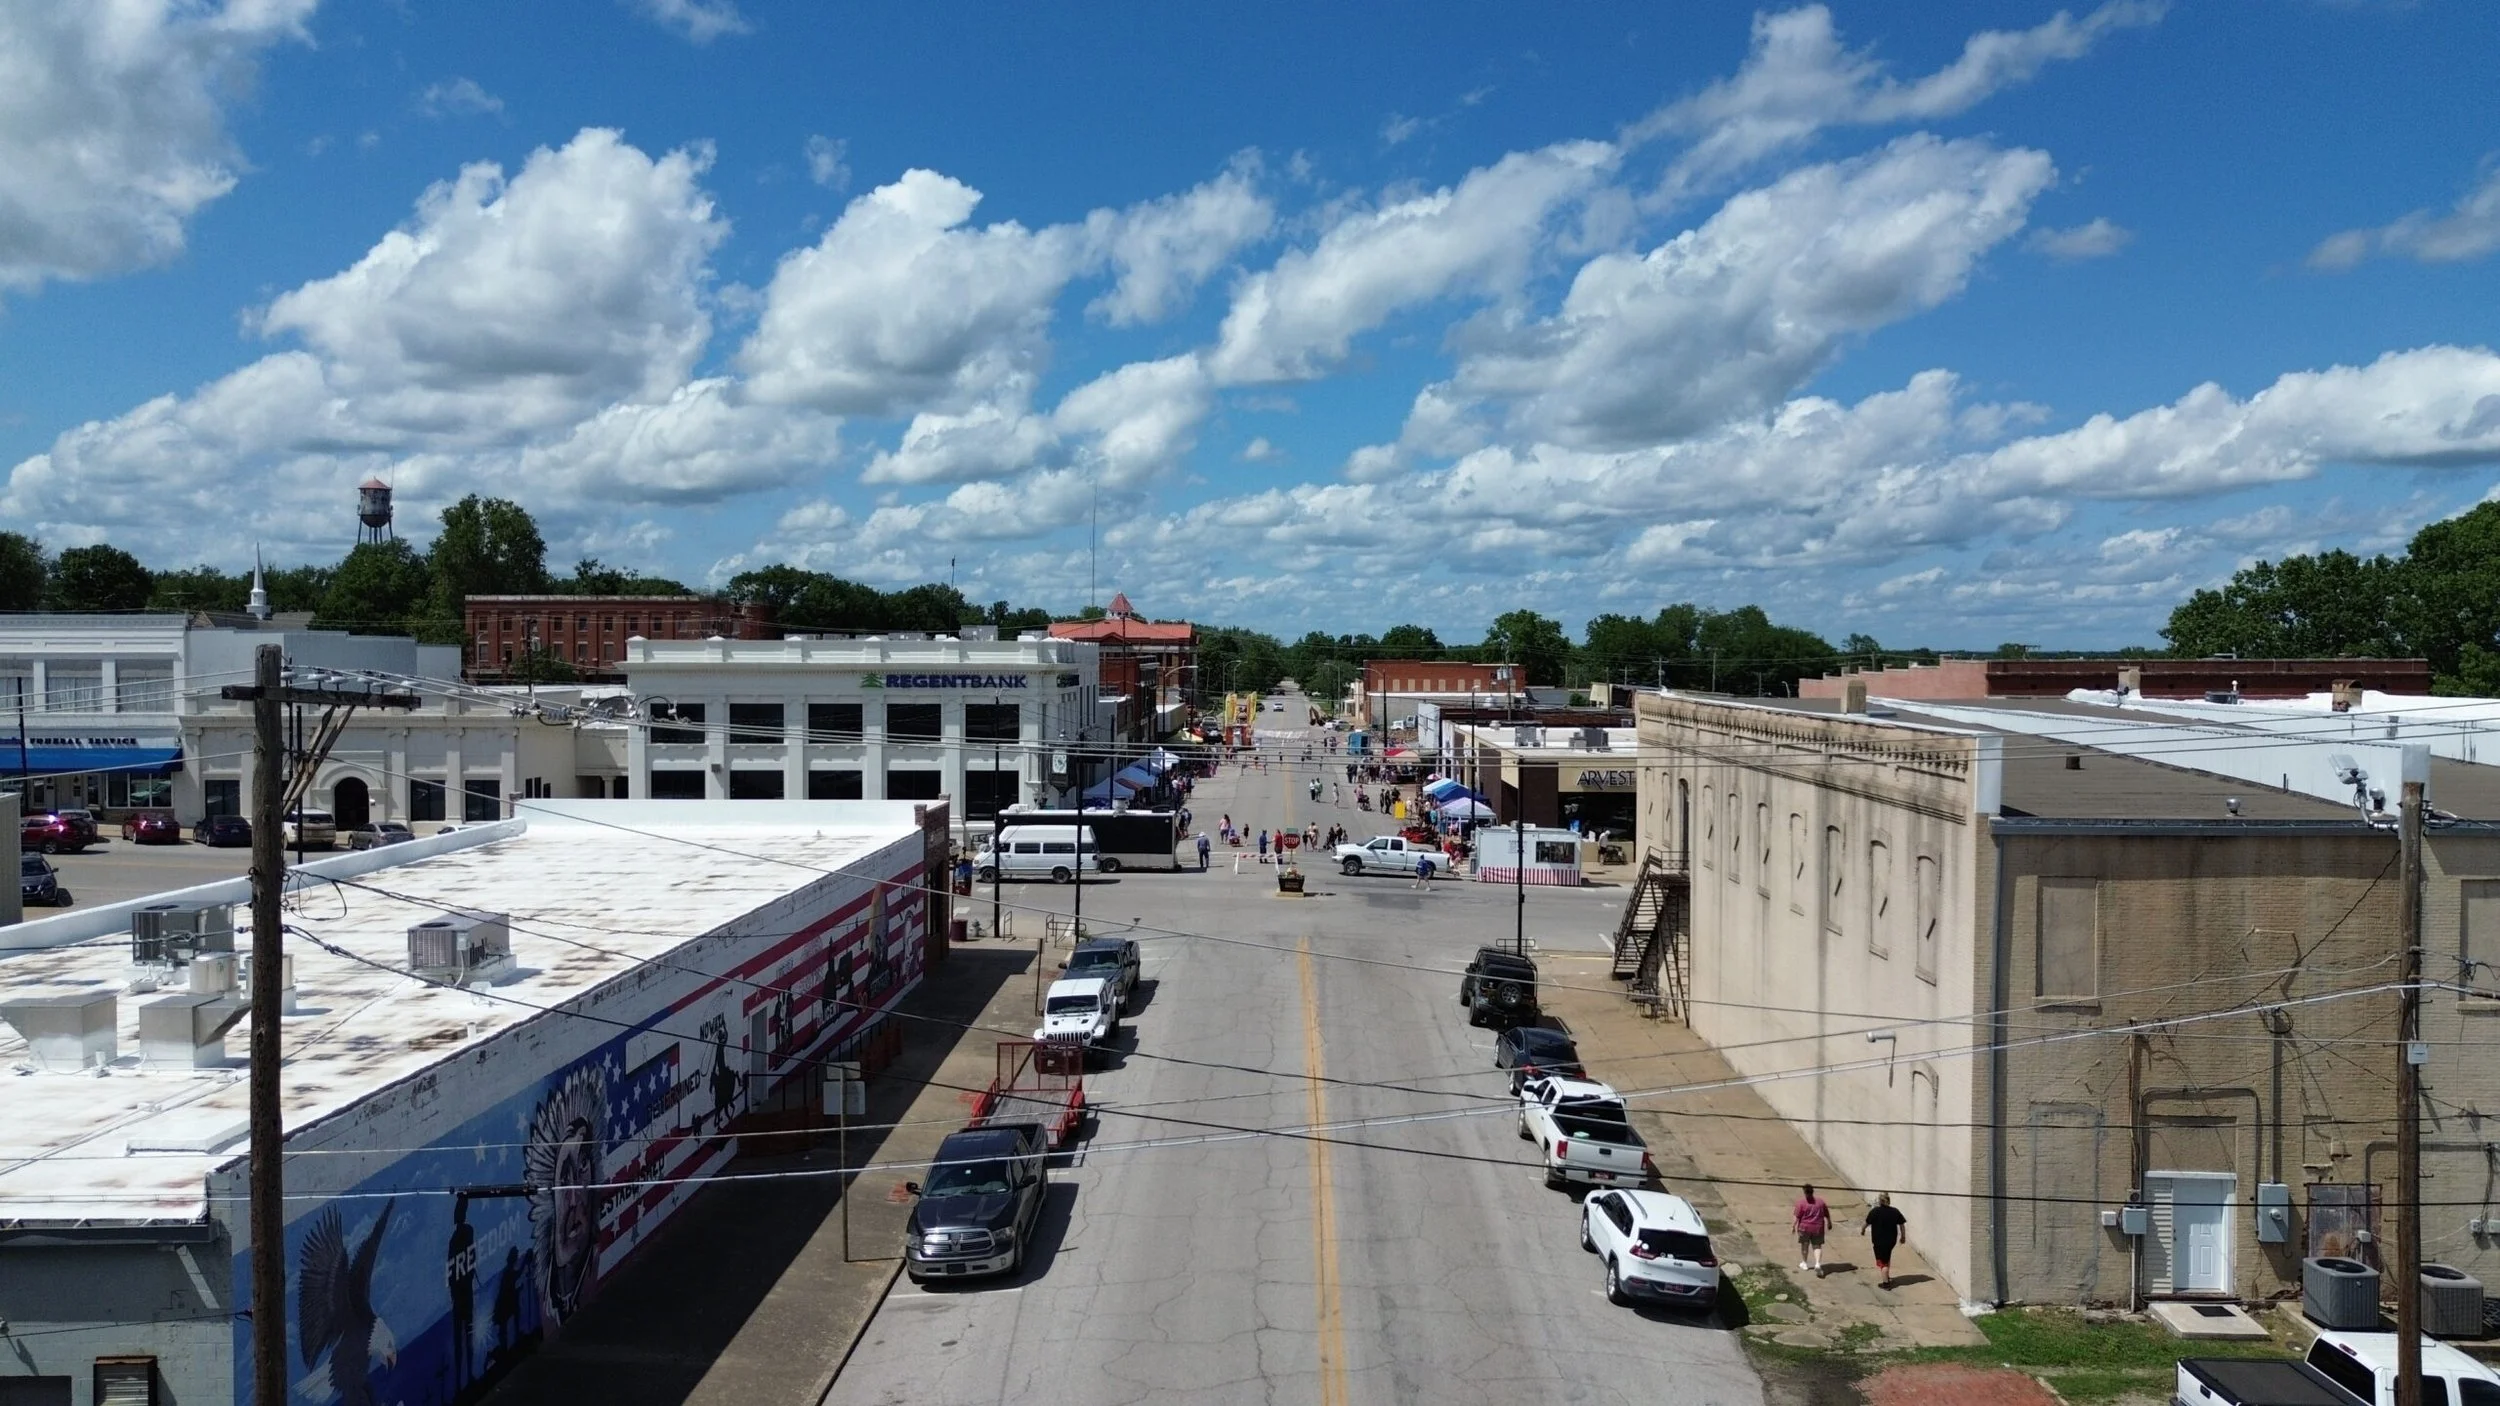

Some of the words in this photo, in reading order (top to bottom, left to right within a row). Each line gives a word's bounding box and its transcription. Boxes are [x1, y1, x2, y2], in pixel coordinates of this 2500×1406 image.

[886, 674, 1027, 688] REGENTBANK
[29, 737, 82, 745] FUNERAL
[88, 737, 137, 745] SERVICE
[1576, 770, 1635, 790] ARVEST
[700, 1011, 726, 1041] NOWATA
[647, 1068, 701, 1121] DETERMINED
[445, 1210, 521, 1288] FREEDOM
